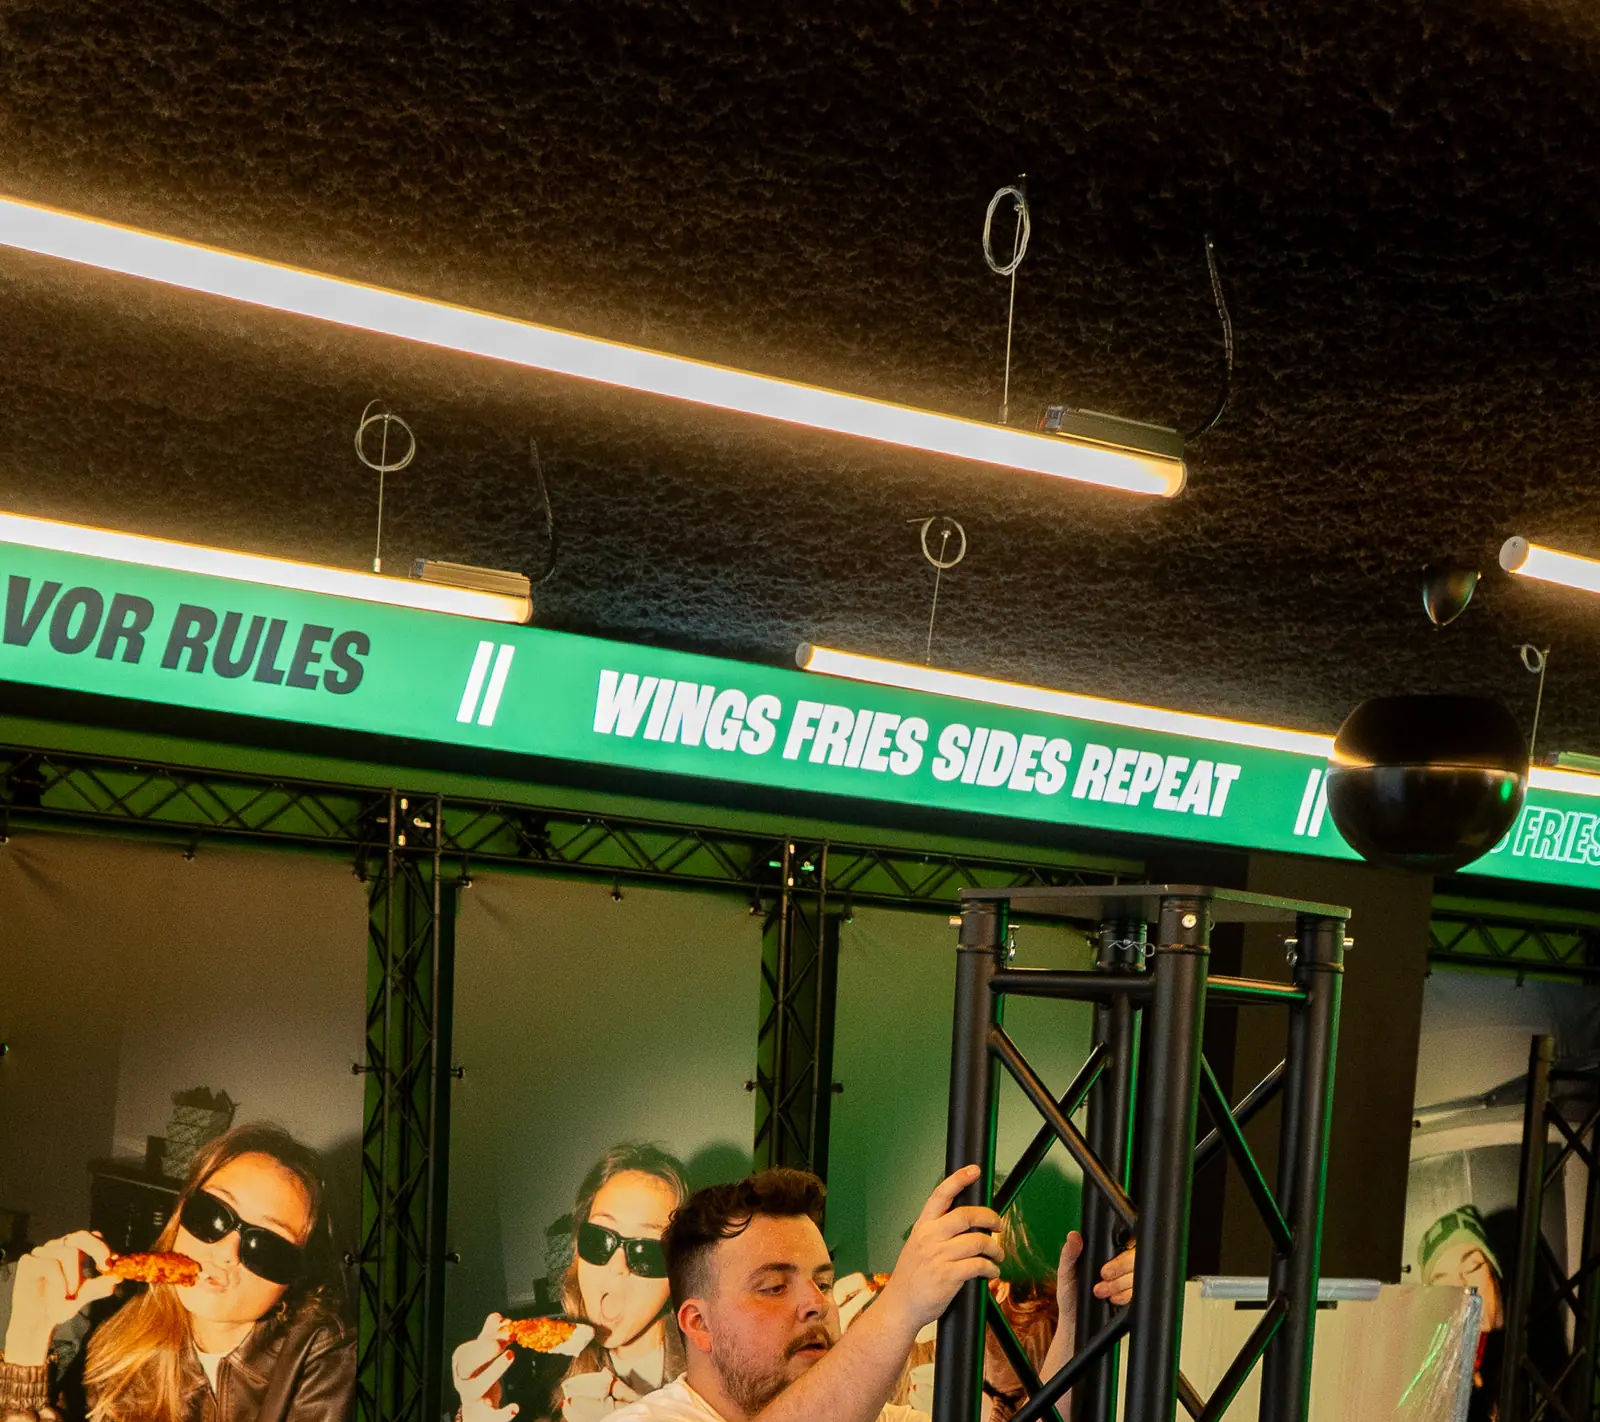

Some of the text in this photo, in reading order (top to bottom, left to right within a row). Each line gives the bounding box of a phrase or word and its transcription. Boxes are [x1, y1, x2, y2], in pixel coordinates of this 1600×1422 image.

[160, 603, 371, 695] RULES
[593, 669, 1242, 818] WINGS FRIES SIDES REPEAT
[1512, 805, 1600, 866] FRIES
